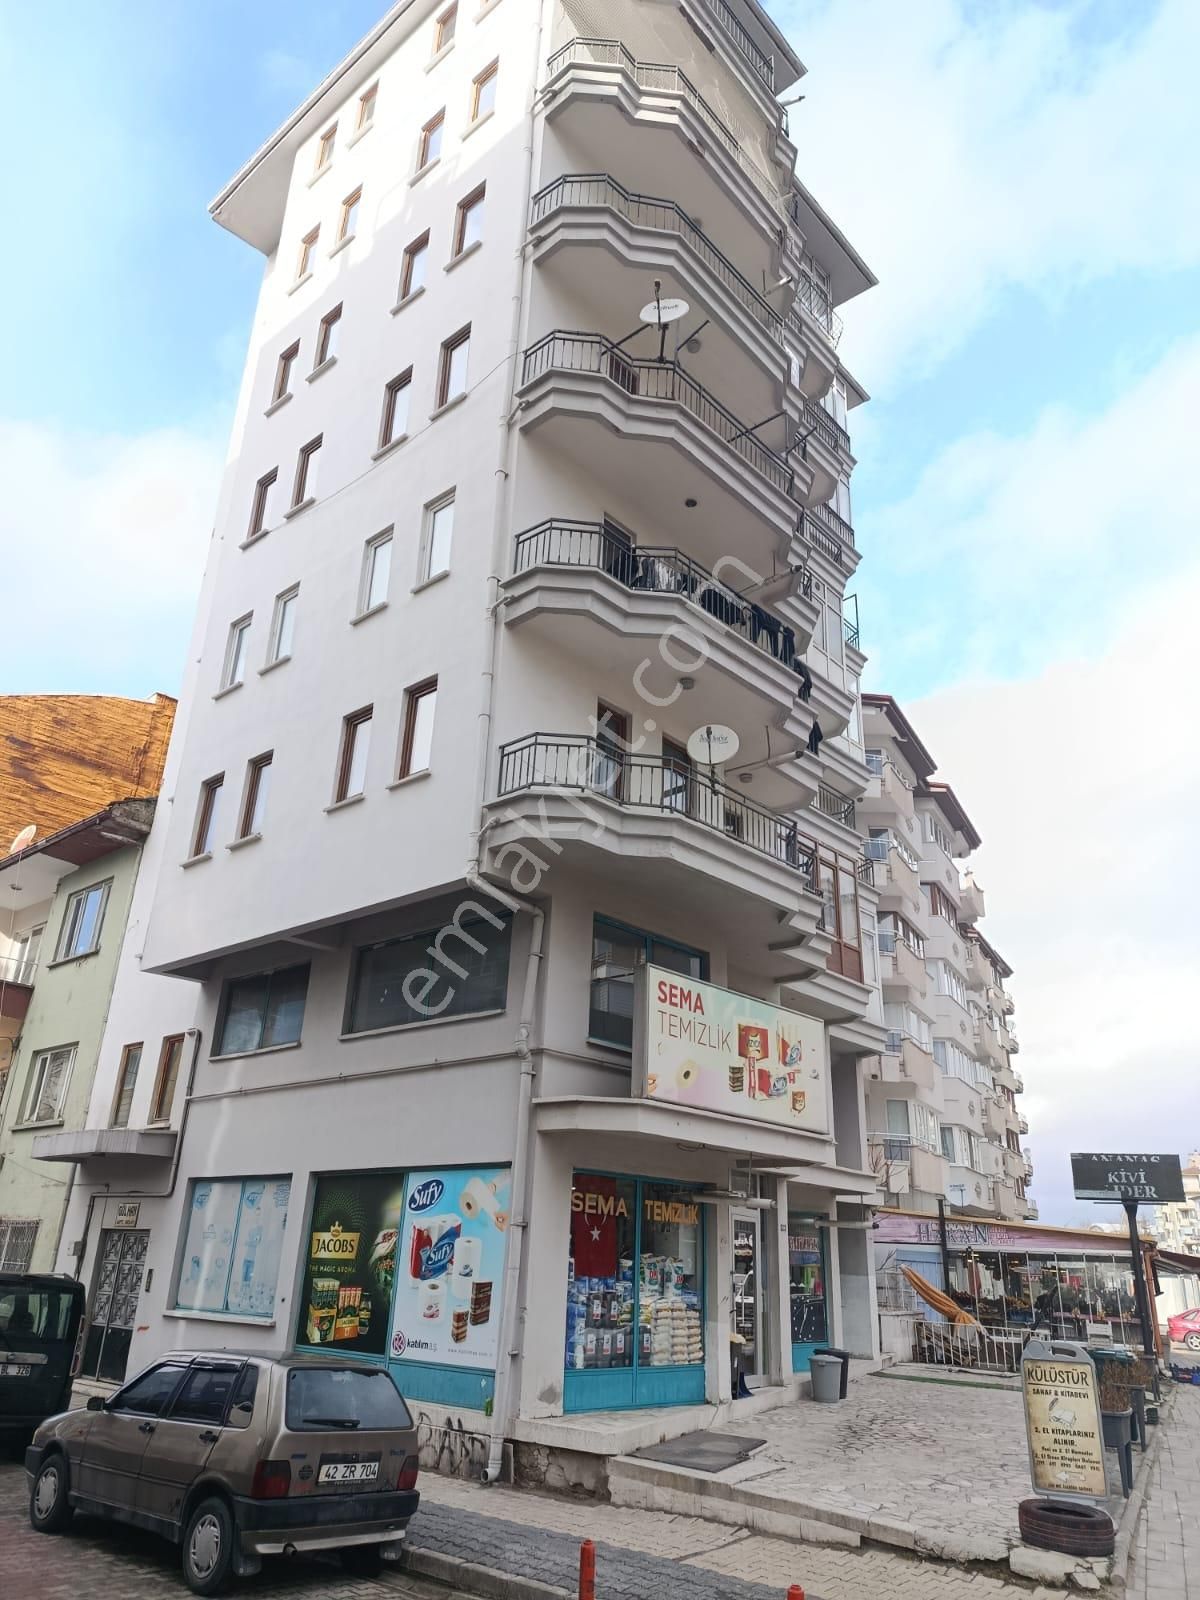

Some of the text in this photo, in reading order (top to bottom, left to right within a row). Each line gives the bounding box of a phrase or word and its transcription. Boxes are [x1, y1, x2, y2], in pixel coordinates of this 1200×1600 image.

[657, 980, 705, 1016] SEMA
[657, 1010, 732, 1054] TEMİZLİK
[1107, 1168, 1147, 1184] KİVİ
[410, 1182, 442, 1209] Sufy
[571, 1191, 628, 1218] SEMA
[644, 1199, 699, 1225] TEMİZLİK
[313, 1238, 355, 1255] JACOBS
[428, 1242, 454, 1265] Sufy
[1027, 1365, 1090, 1387] KÜLÜSTÜR
[1060, 1389, 1089, 1400] KİTABEVİ
[1051, 1427, 1096, 1439] KİTAPLARINIZ
[325, 1463, 377, 1480] 42 ZR 704
